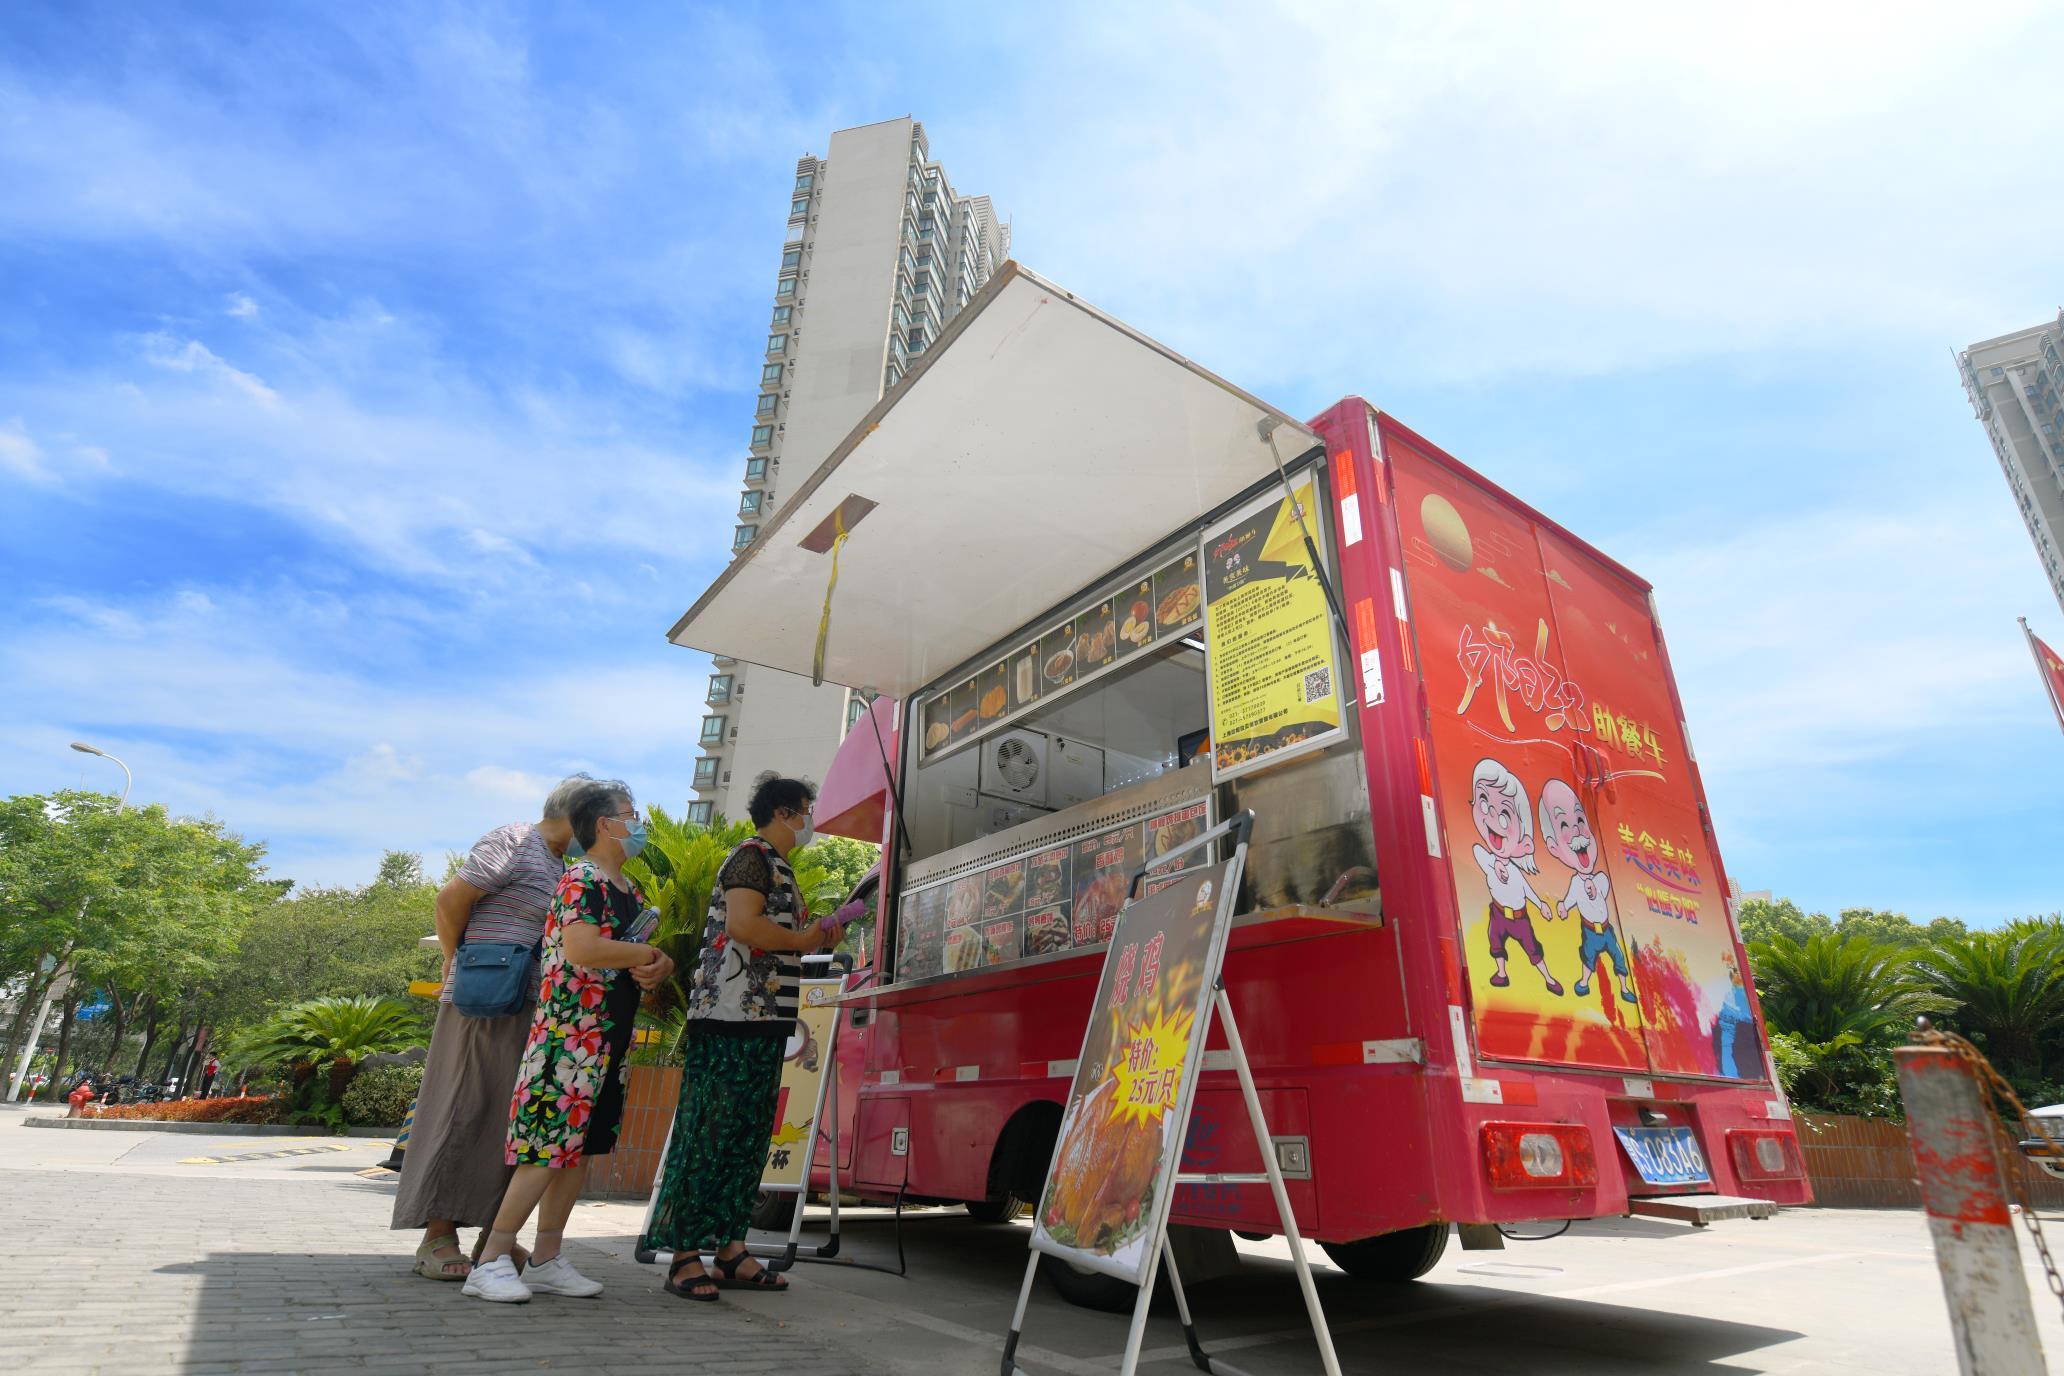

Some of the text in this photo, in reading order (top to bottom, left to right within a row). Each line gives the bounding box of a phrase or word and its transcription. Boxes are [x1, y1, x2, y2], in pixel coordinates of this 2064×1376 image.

[1592, 702, 1669, 771] 助餐车
[1618, 822, 1701, 886] 美食美味
[1108, 931, 1165, 1008] 烧鸡
[1128, 1037, 1159, 1073] 特价：
[1128, 1067, 1176, 1104] 25元/只
